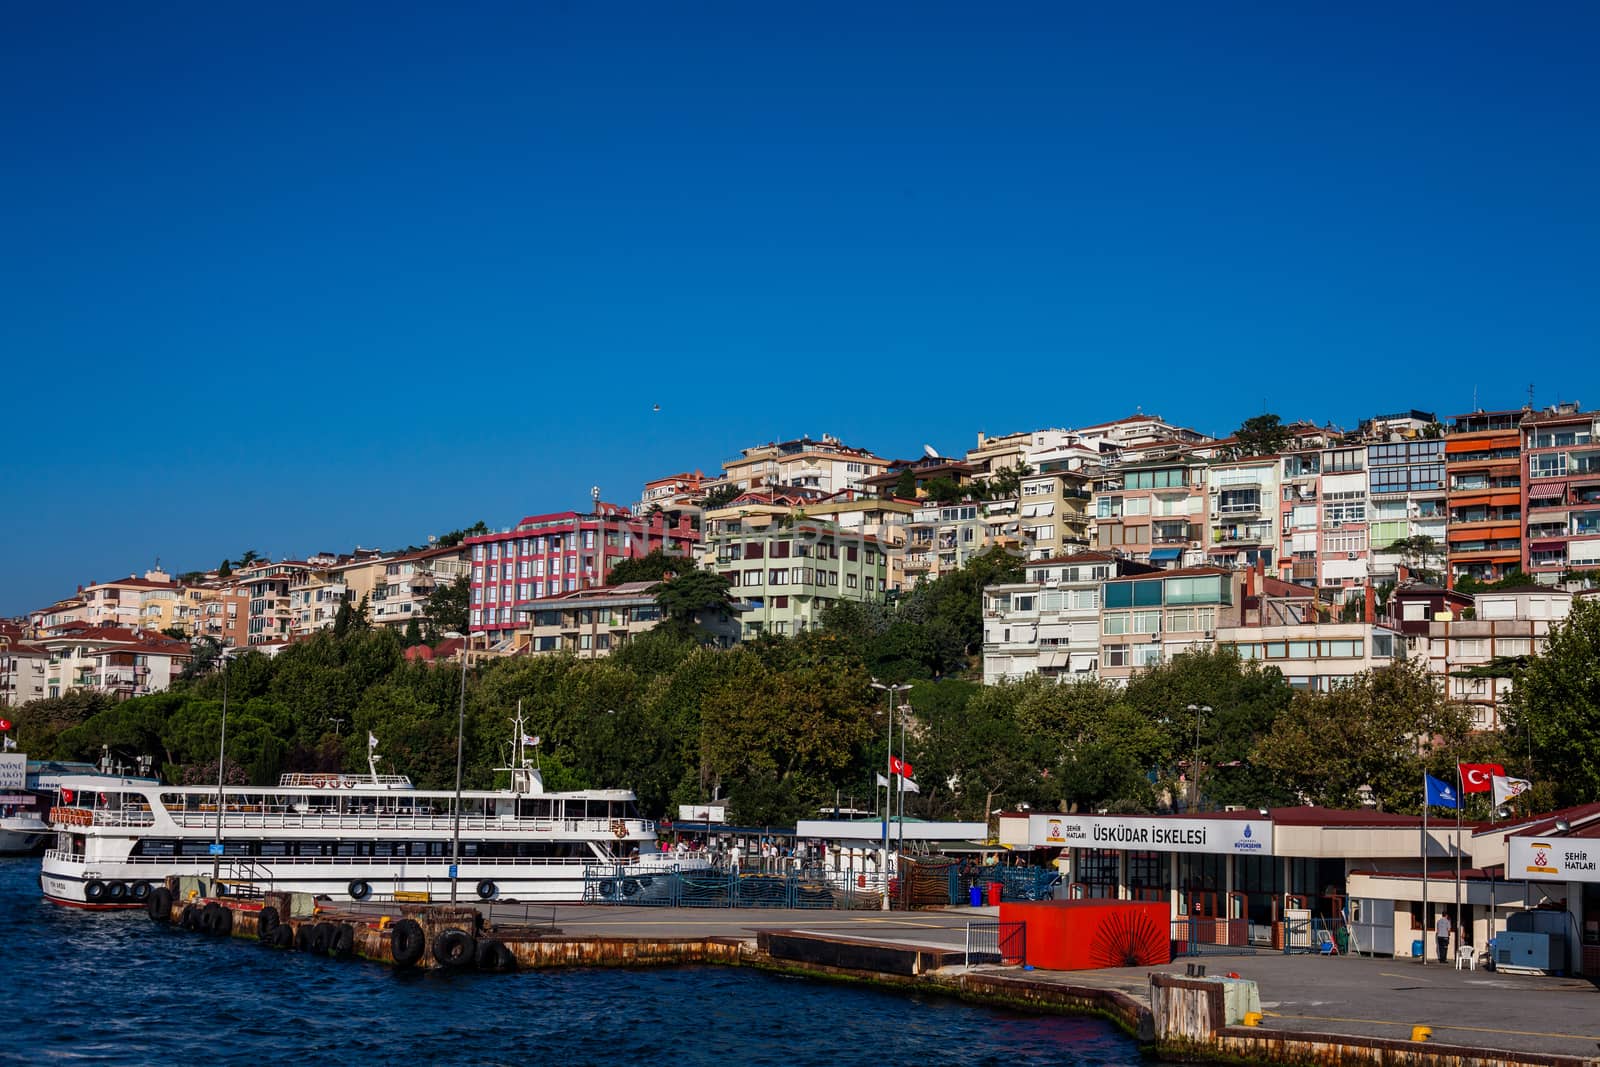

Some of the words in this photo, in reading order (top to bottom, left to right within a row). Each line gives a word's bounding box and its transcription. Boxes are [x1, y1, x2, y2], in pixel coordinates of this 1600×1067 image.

[1093, 823, 1148, 843] ÜSKÜDAR
[1152, 825, 1206, 845] İSKELESİ
[1564, 851, 1587, 861] ŞEHİR
[1564, 861, 1596, 870] HATLARI
